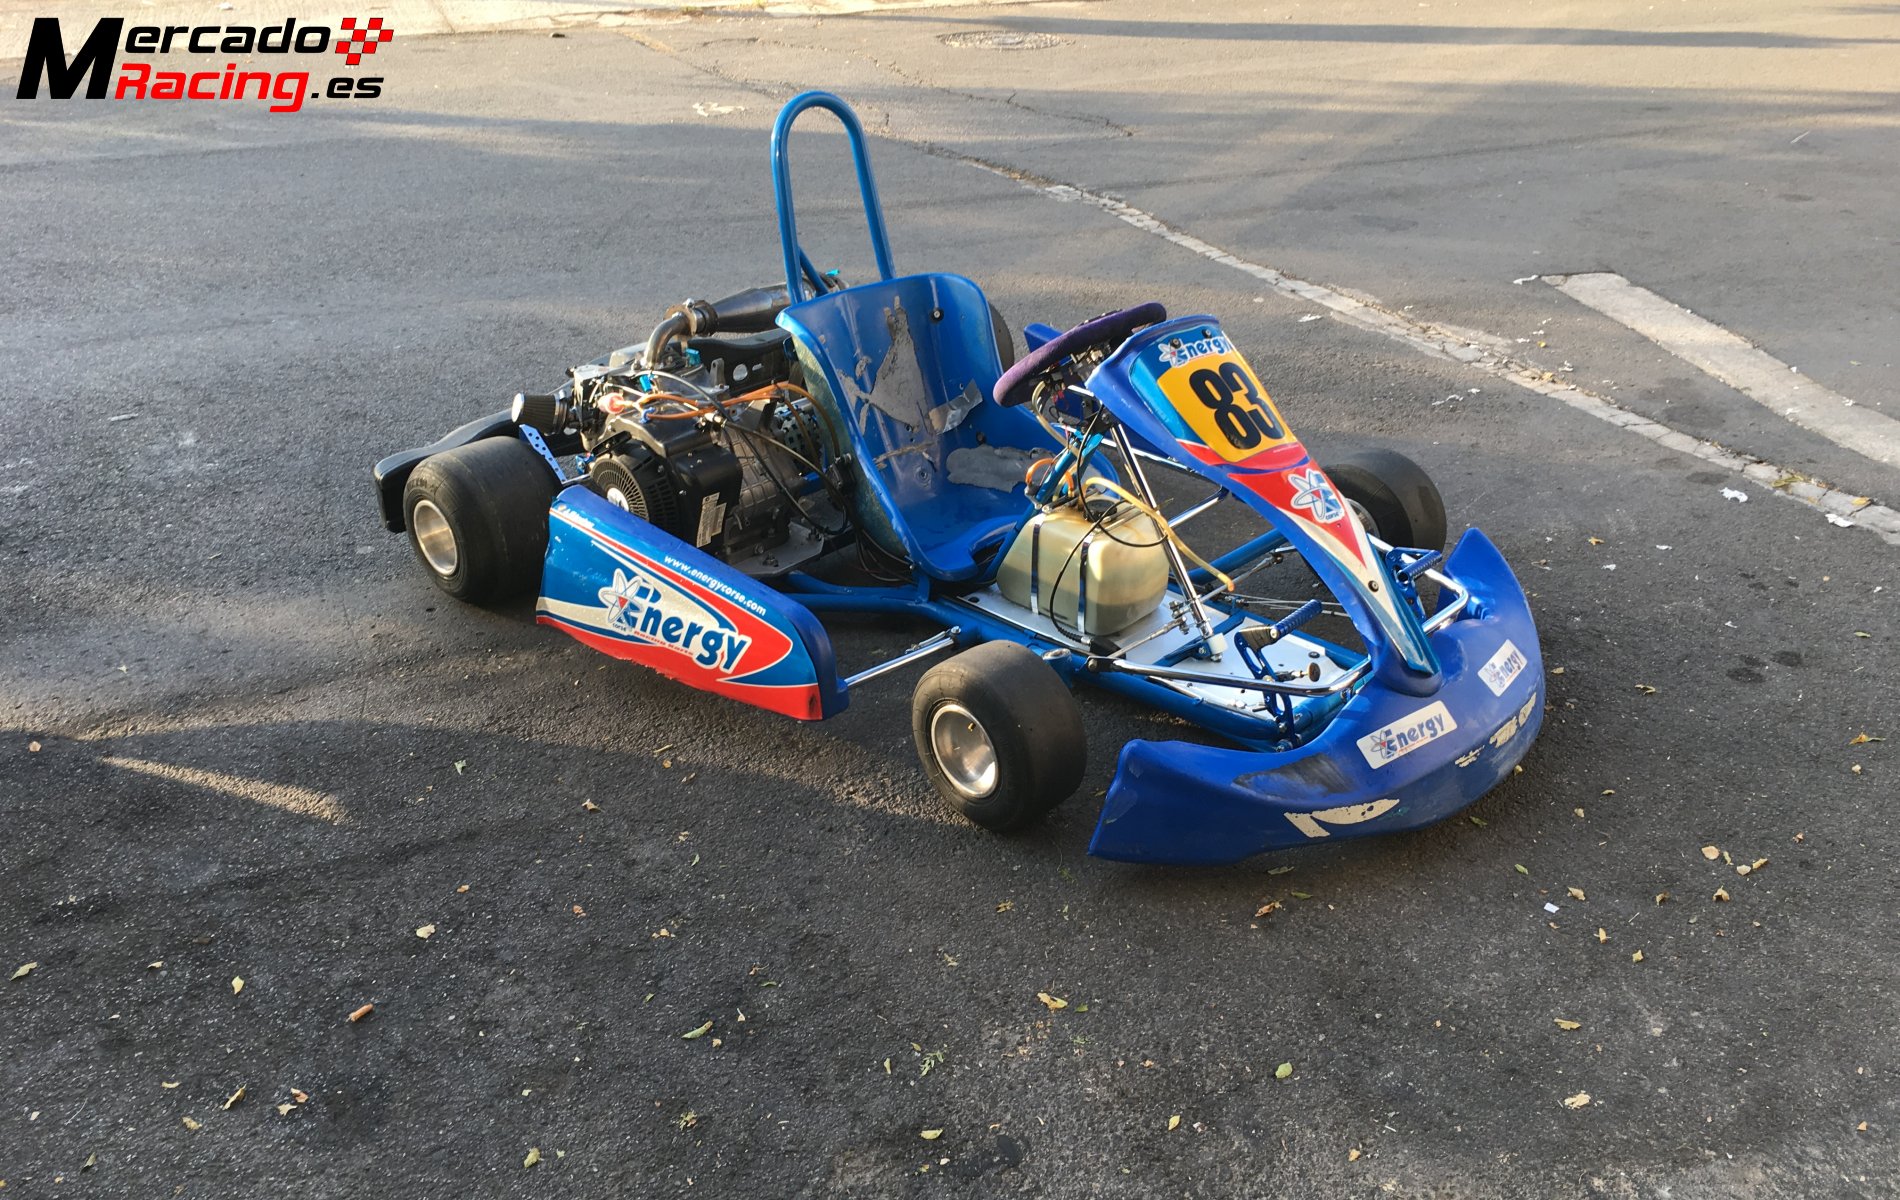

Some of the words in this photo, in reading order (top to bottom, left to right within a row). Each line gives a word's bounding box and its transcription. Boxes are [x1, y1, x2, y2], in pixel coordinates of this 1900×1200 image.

[1188, 362, 1285, 450] 83
[664, 556, 767, 616] www.energycorse.com
[614, 585, 748, 671] Energy
[1384, 713, 1444, 757] Energy
